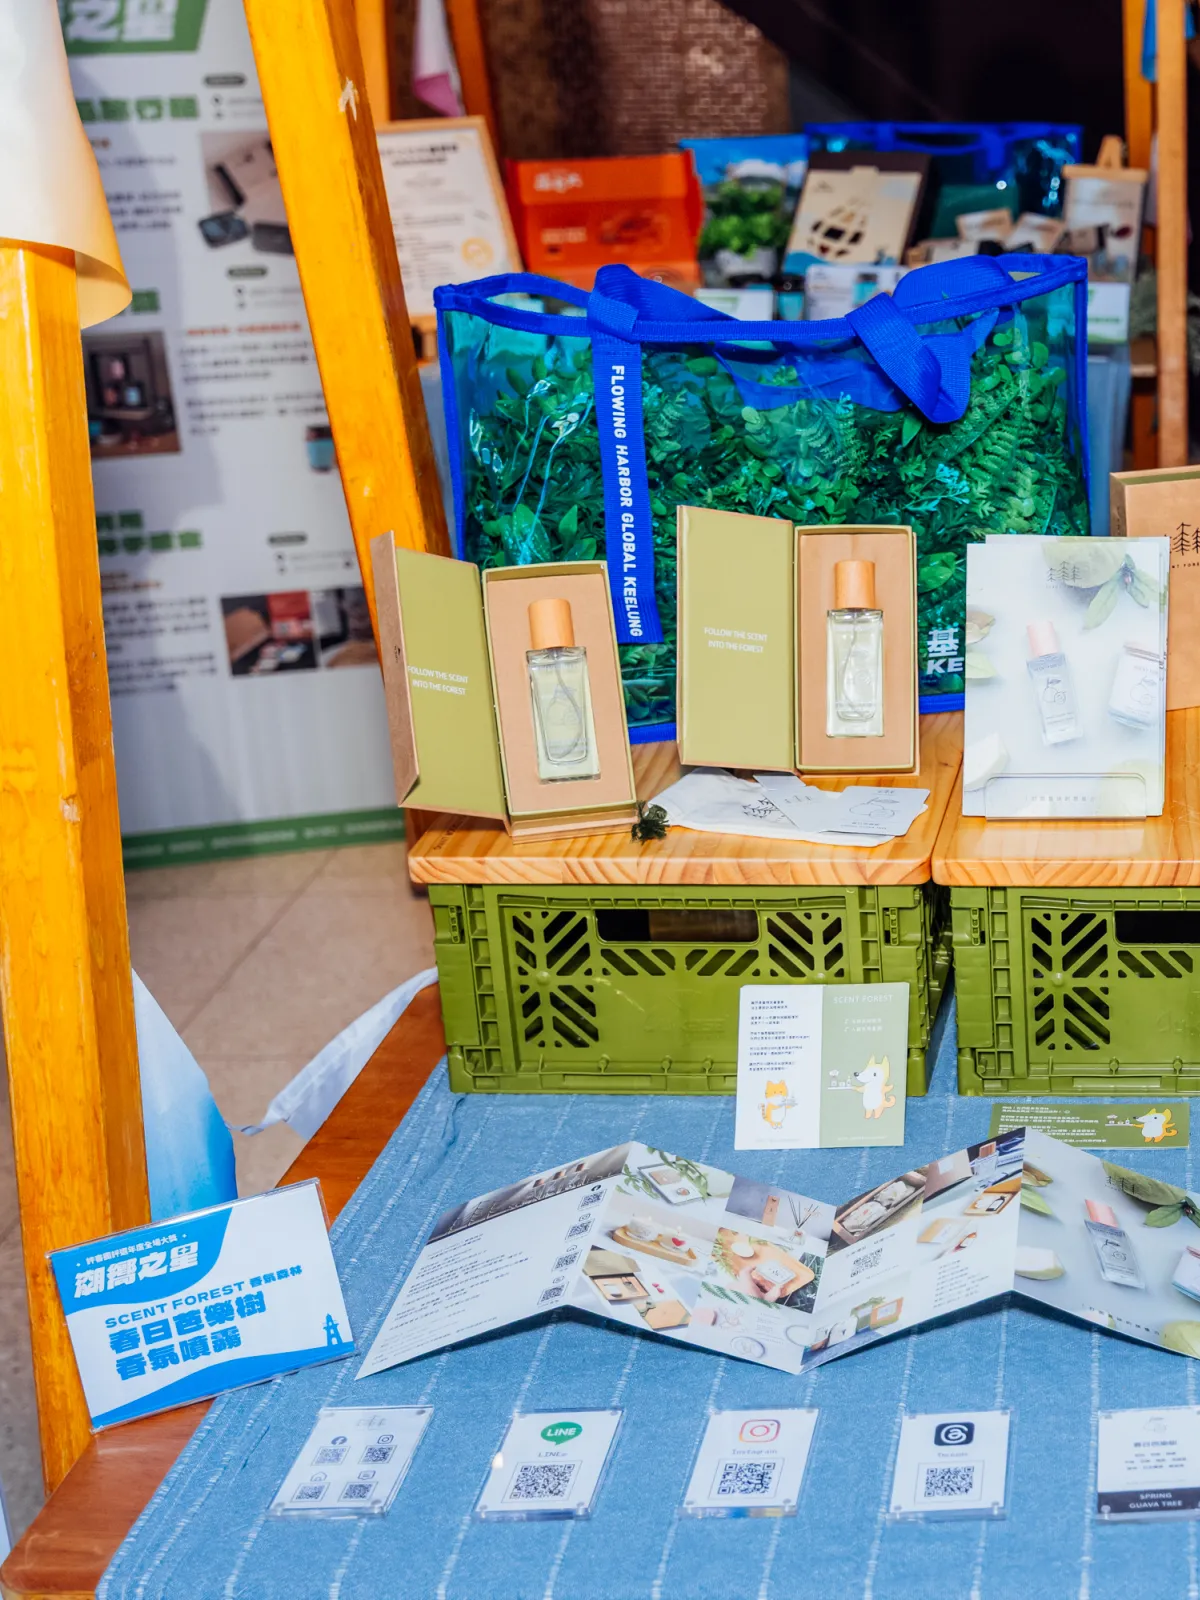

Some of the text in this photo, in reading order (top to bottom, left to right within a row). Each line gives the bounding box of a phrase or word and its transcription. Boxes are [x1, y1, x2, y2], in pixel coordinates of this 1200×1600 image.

[611, 365, 643, 637] FLOWING HARBOR GLOBAL KEELUNG
[704, 626, 768, 642] FOLLOW THE SCENT
[708, 639, 725, 649] INTO
[739, 643, 764, 653] FOREST
[407, 665, 469, 684] FOLLOW THE SCENT
[412, 679, 466, 695] INTO THE FOREST
[833, 994, 893, 1004] SCENT FOREST
[105, 1265, 303, 1328] SCENT FOREST 香氛森林
[109, 1291, 266, 1354] 春日芭樂樹
[116, 1325, 242, 1381] 香氛噴霧
[546, 1427, 577, 1437] LINE
[1129, 1501, 1159, 1509] GUAVA
